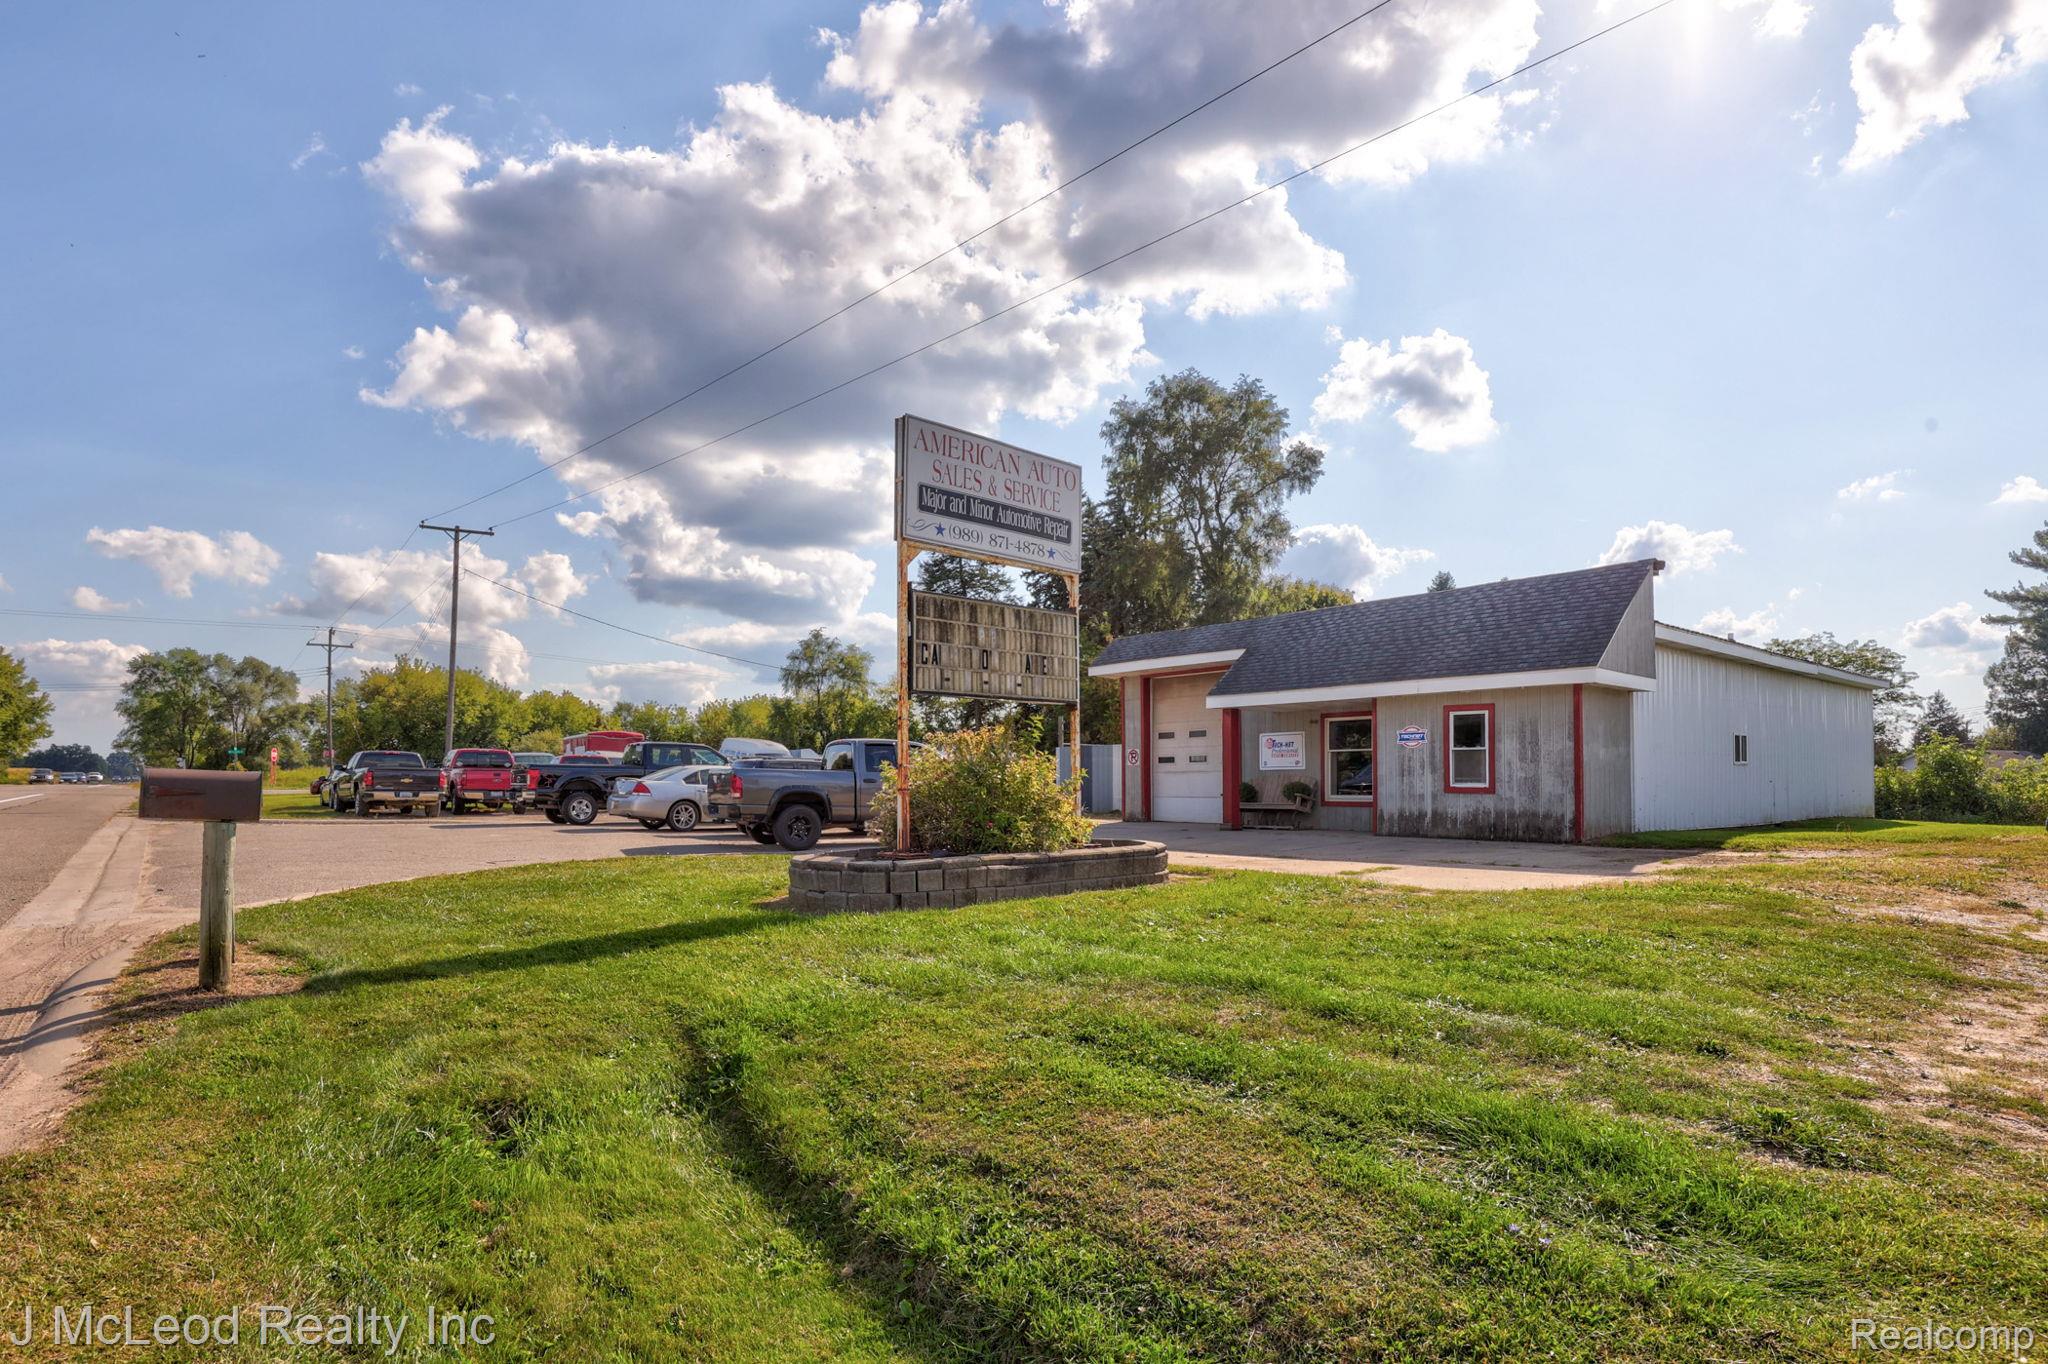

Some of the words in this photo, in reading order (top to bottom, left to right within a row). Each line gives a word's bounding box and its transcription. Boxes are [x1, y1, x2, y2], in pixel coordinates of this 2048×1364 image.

[914, 428, 1020, 476] AMERICAN
[1028, 461, 1077, 491] AUTO
[932, 459, 982, 493] SALES
[988, 475, 997, 497] &
[1004, 478, 1061, 513] SERVICE
[922, 487, 947, 513] Major
[950, 495, 967, 515] and
[970, 499, 995, 521] Minor
[997, 506, 1042, 532] Automotive
[1043, 516, 1069, 541] Repair
[949, 525, 984, 544] (989)
[989, 532, 1046, 556] 871-4878
